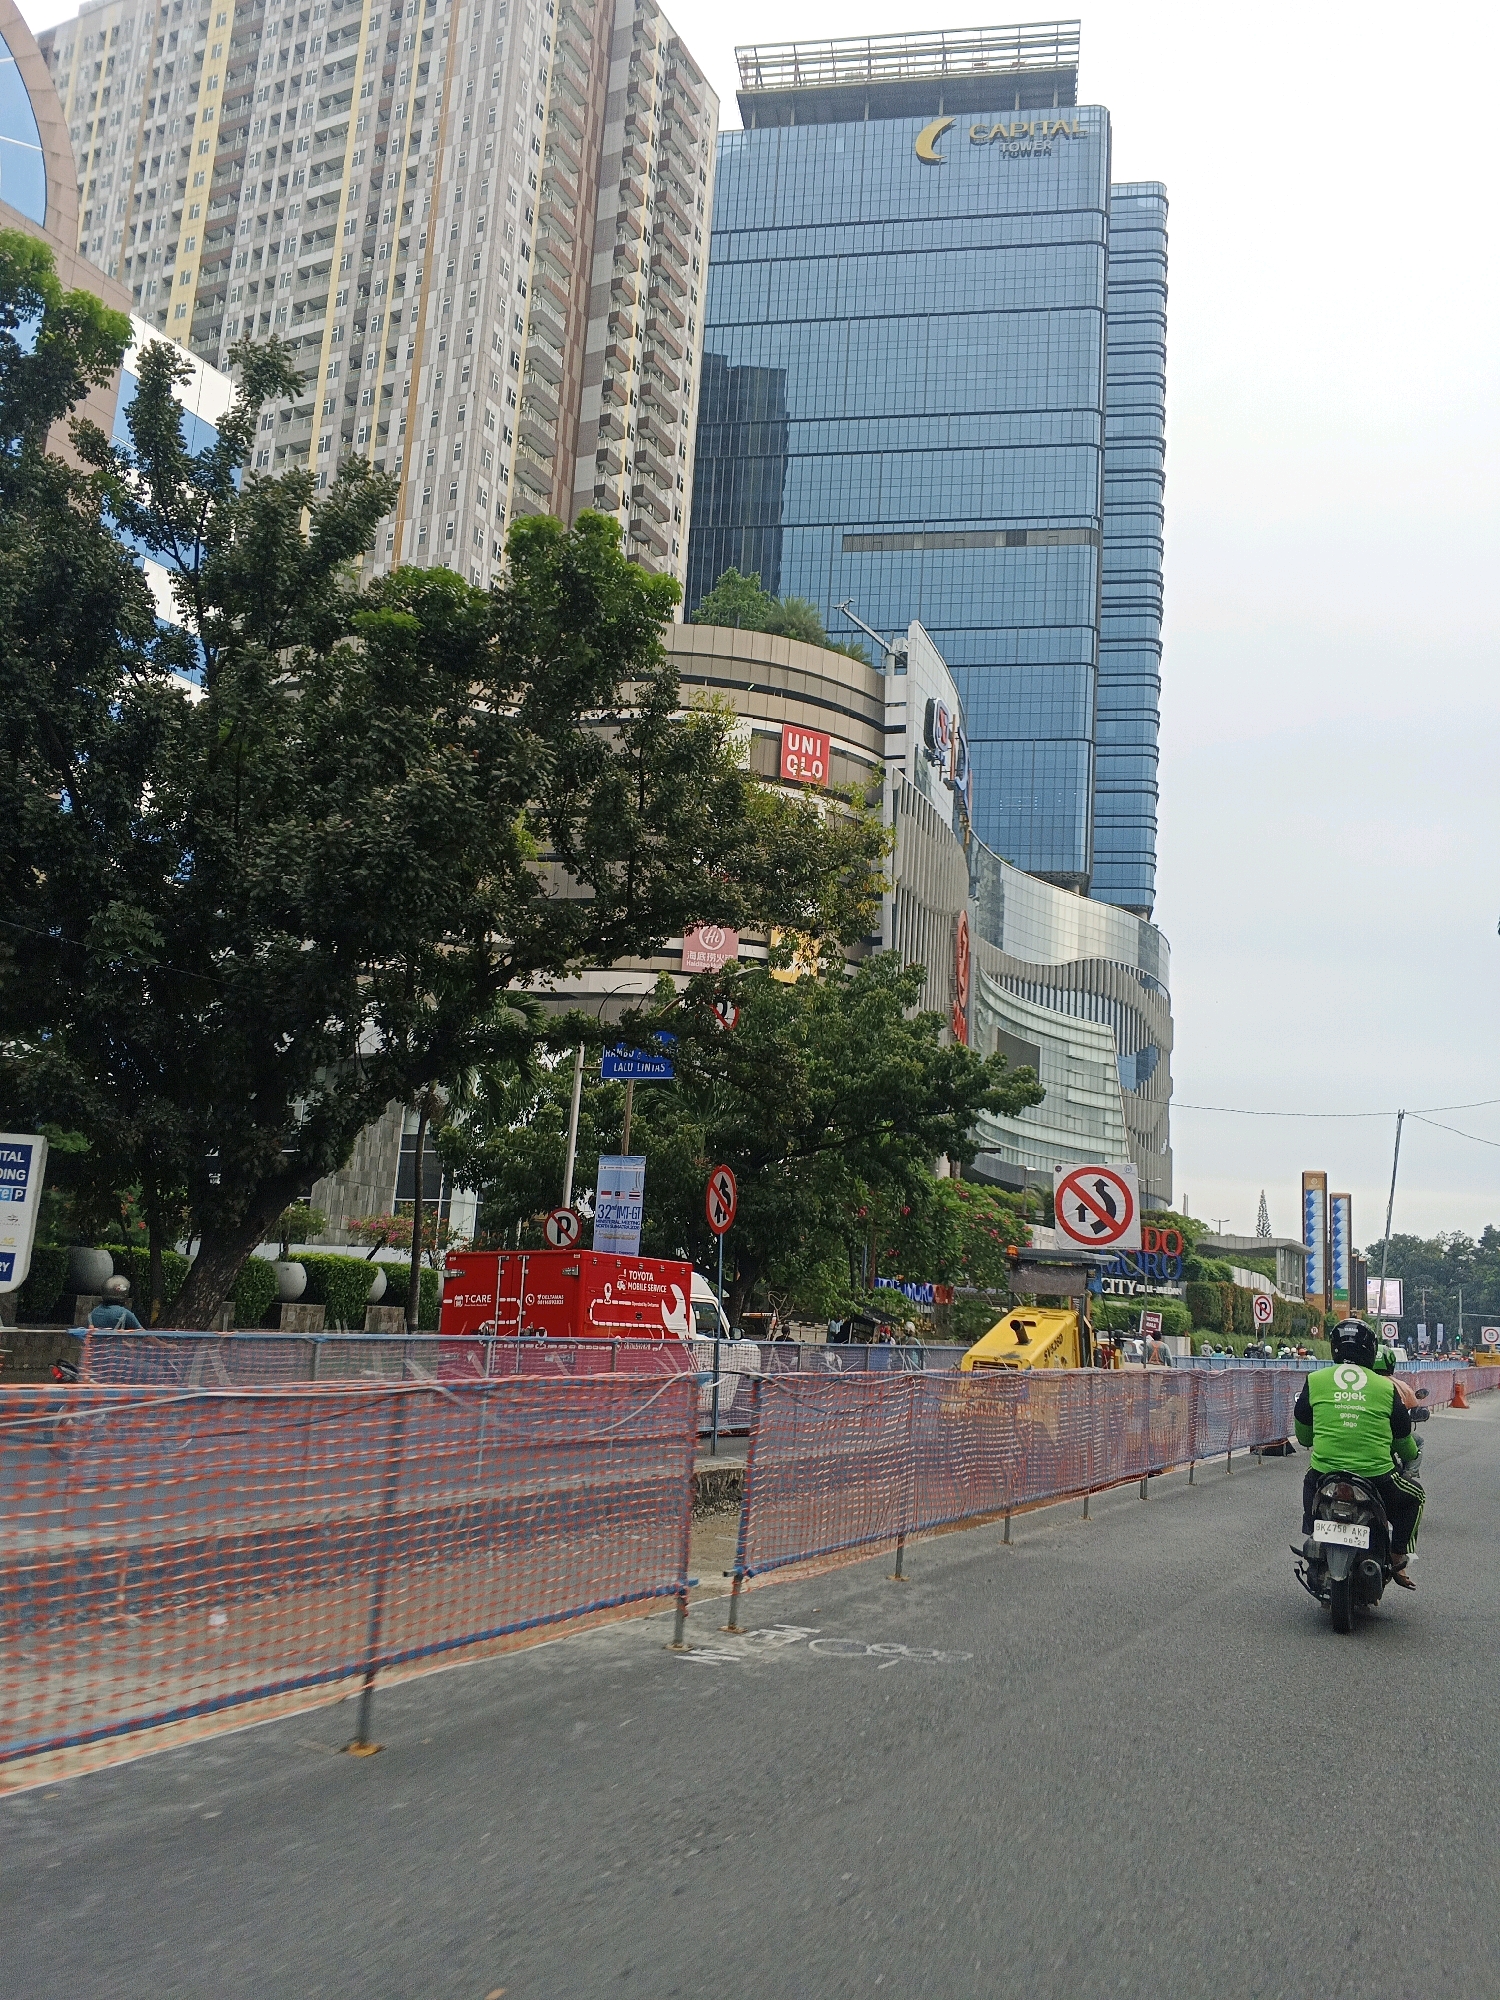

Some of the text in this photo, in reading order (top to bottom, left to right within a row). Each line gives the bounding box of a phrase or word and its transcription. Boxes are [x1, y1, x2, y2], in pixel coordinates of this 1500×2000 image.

[969, 119, 1088, 141] CAPITAL
[1000, 140, 1052, 152] TOWER
[788, 732, 821, 757] UNI
[786, 754, 823, 779] QLO
[613, 1062, 666, 1072] LALU LINTAS
[14, 1190, 24, 1200] P
[617, 1205, 642, 1220] IMT-GT
[556, 1215, 572, 1245] P
[1143, 1226, 1185, 1257] DO
[629, 1270, 654, 1282] TOYOTA
[627, 1282, 668, 1293] MOBILE SERVICE
[1101, 1277, 1137, 1296] CITY
[1334, 1391, 1367, 1402] gojek
[1334, 1403, 1366, 1411] tokopedia
[1340, 1412, 1360, 1420] gopay
